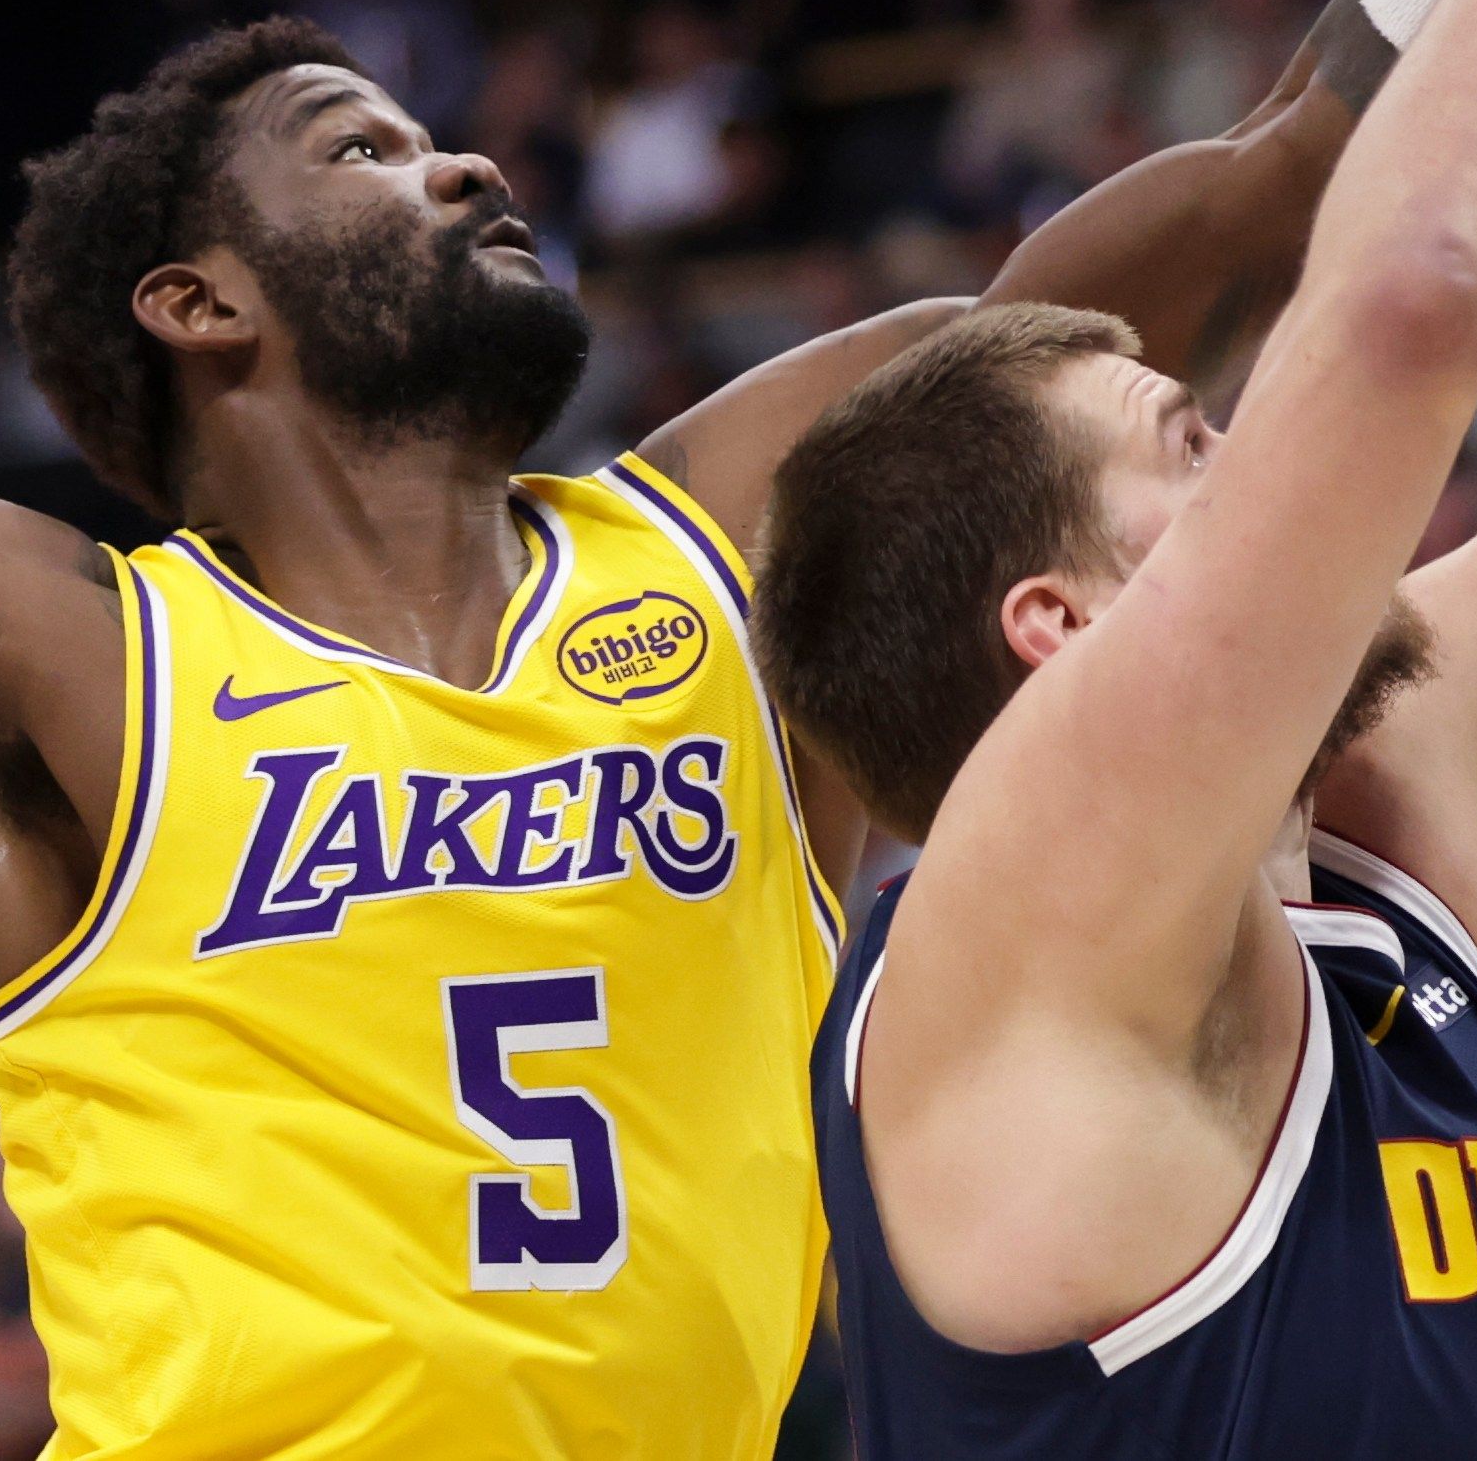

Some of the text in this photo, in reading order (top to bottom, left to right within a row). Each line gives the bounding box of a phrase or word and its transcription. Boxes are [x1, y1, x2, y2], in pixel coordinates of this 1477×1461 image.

[567, 615, 695, 676] bibigo
[602, 655, 657, 684] 비비고
[193, 733, 739, 962] LAKERS
[440, 966, 628, 1292] 5
